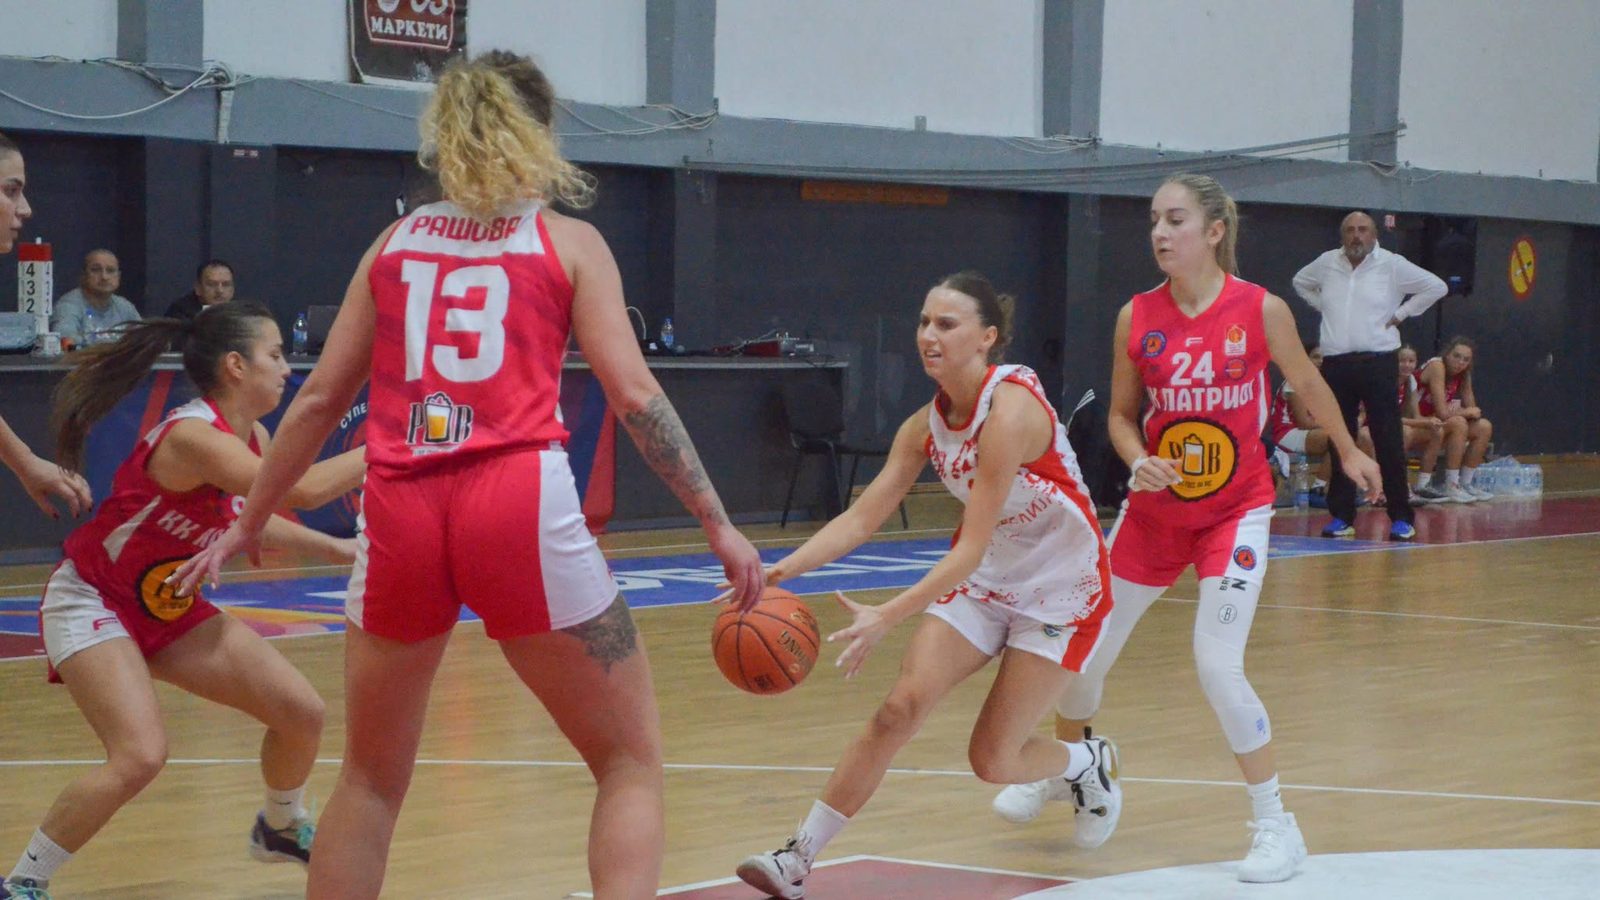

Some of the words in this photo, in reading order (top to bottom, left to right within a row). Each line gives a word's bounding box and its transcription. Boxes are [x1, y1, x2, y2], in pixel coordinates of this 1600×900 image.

[370, 16, 448, 41] МАРКЕТИ
[25, 262, 36, 278] 4
[26, 280, 36, 296] 3
[26, 298, 35, 313] 2
[400, 258, 511, 383] 13
[1170, 351, 1216, 386] 24
[339, 402, 370, 430] СУПЕ
